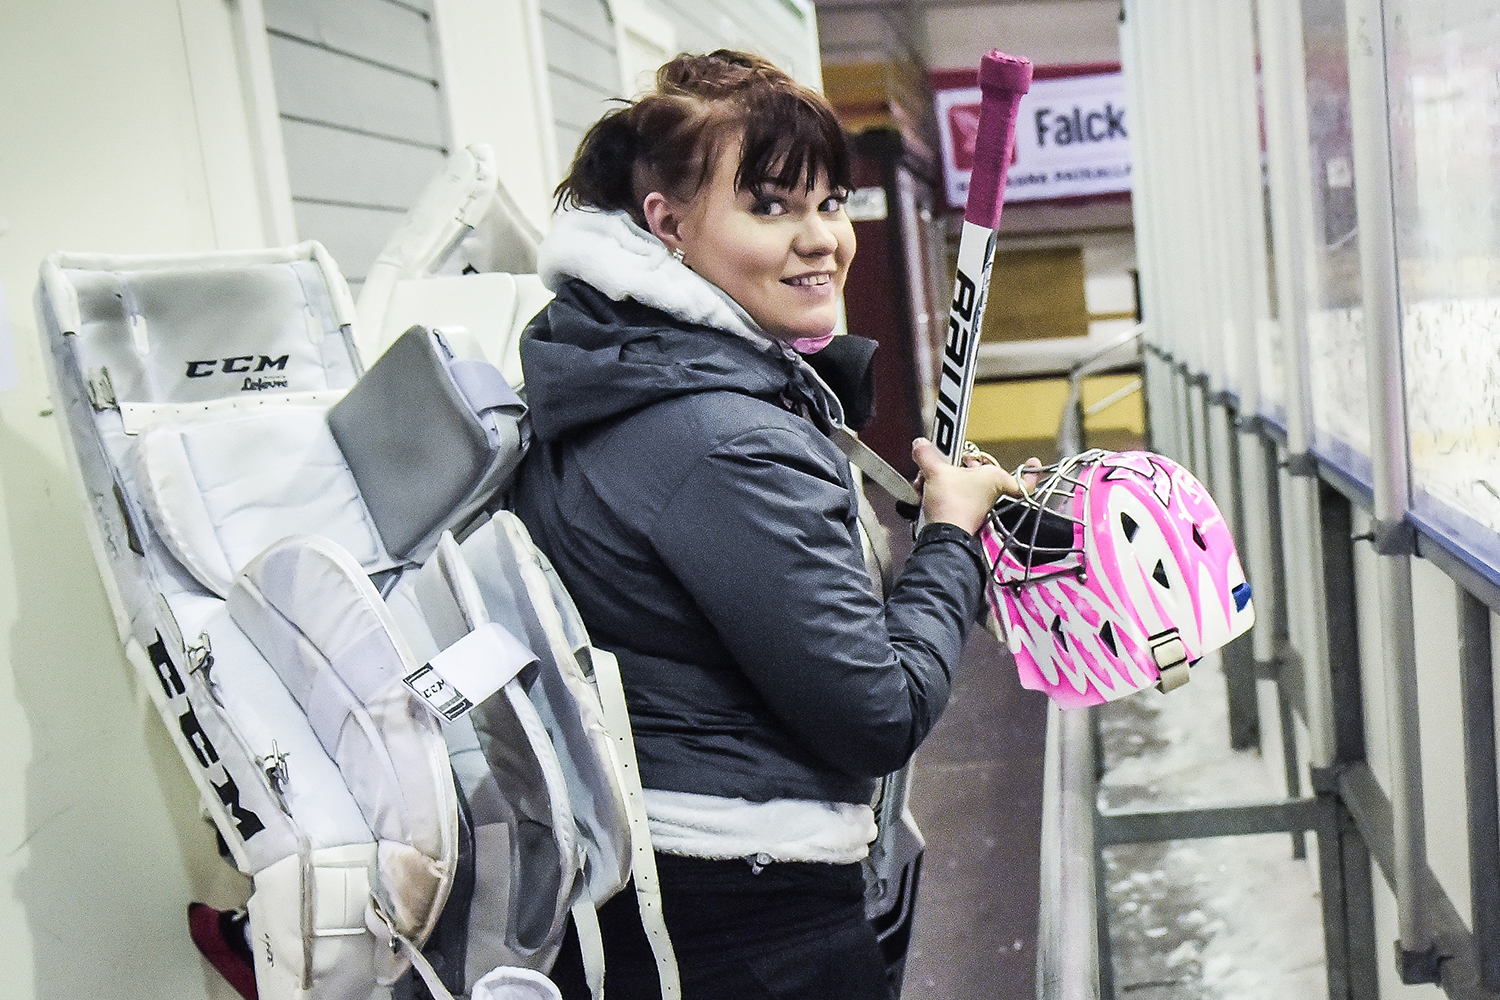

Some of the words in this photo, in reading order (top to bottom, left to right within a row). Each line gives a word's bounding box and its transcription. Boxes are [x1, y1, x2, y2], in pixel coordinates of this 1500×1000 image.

[1034, 102, 1128, 148] Falck
[185, 354, 289, 378] CCM
[936, 268, 976, 457] BAUE
[423, 678, 446, 699] CCM
[147, 627, 266, 842] CCM
